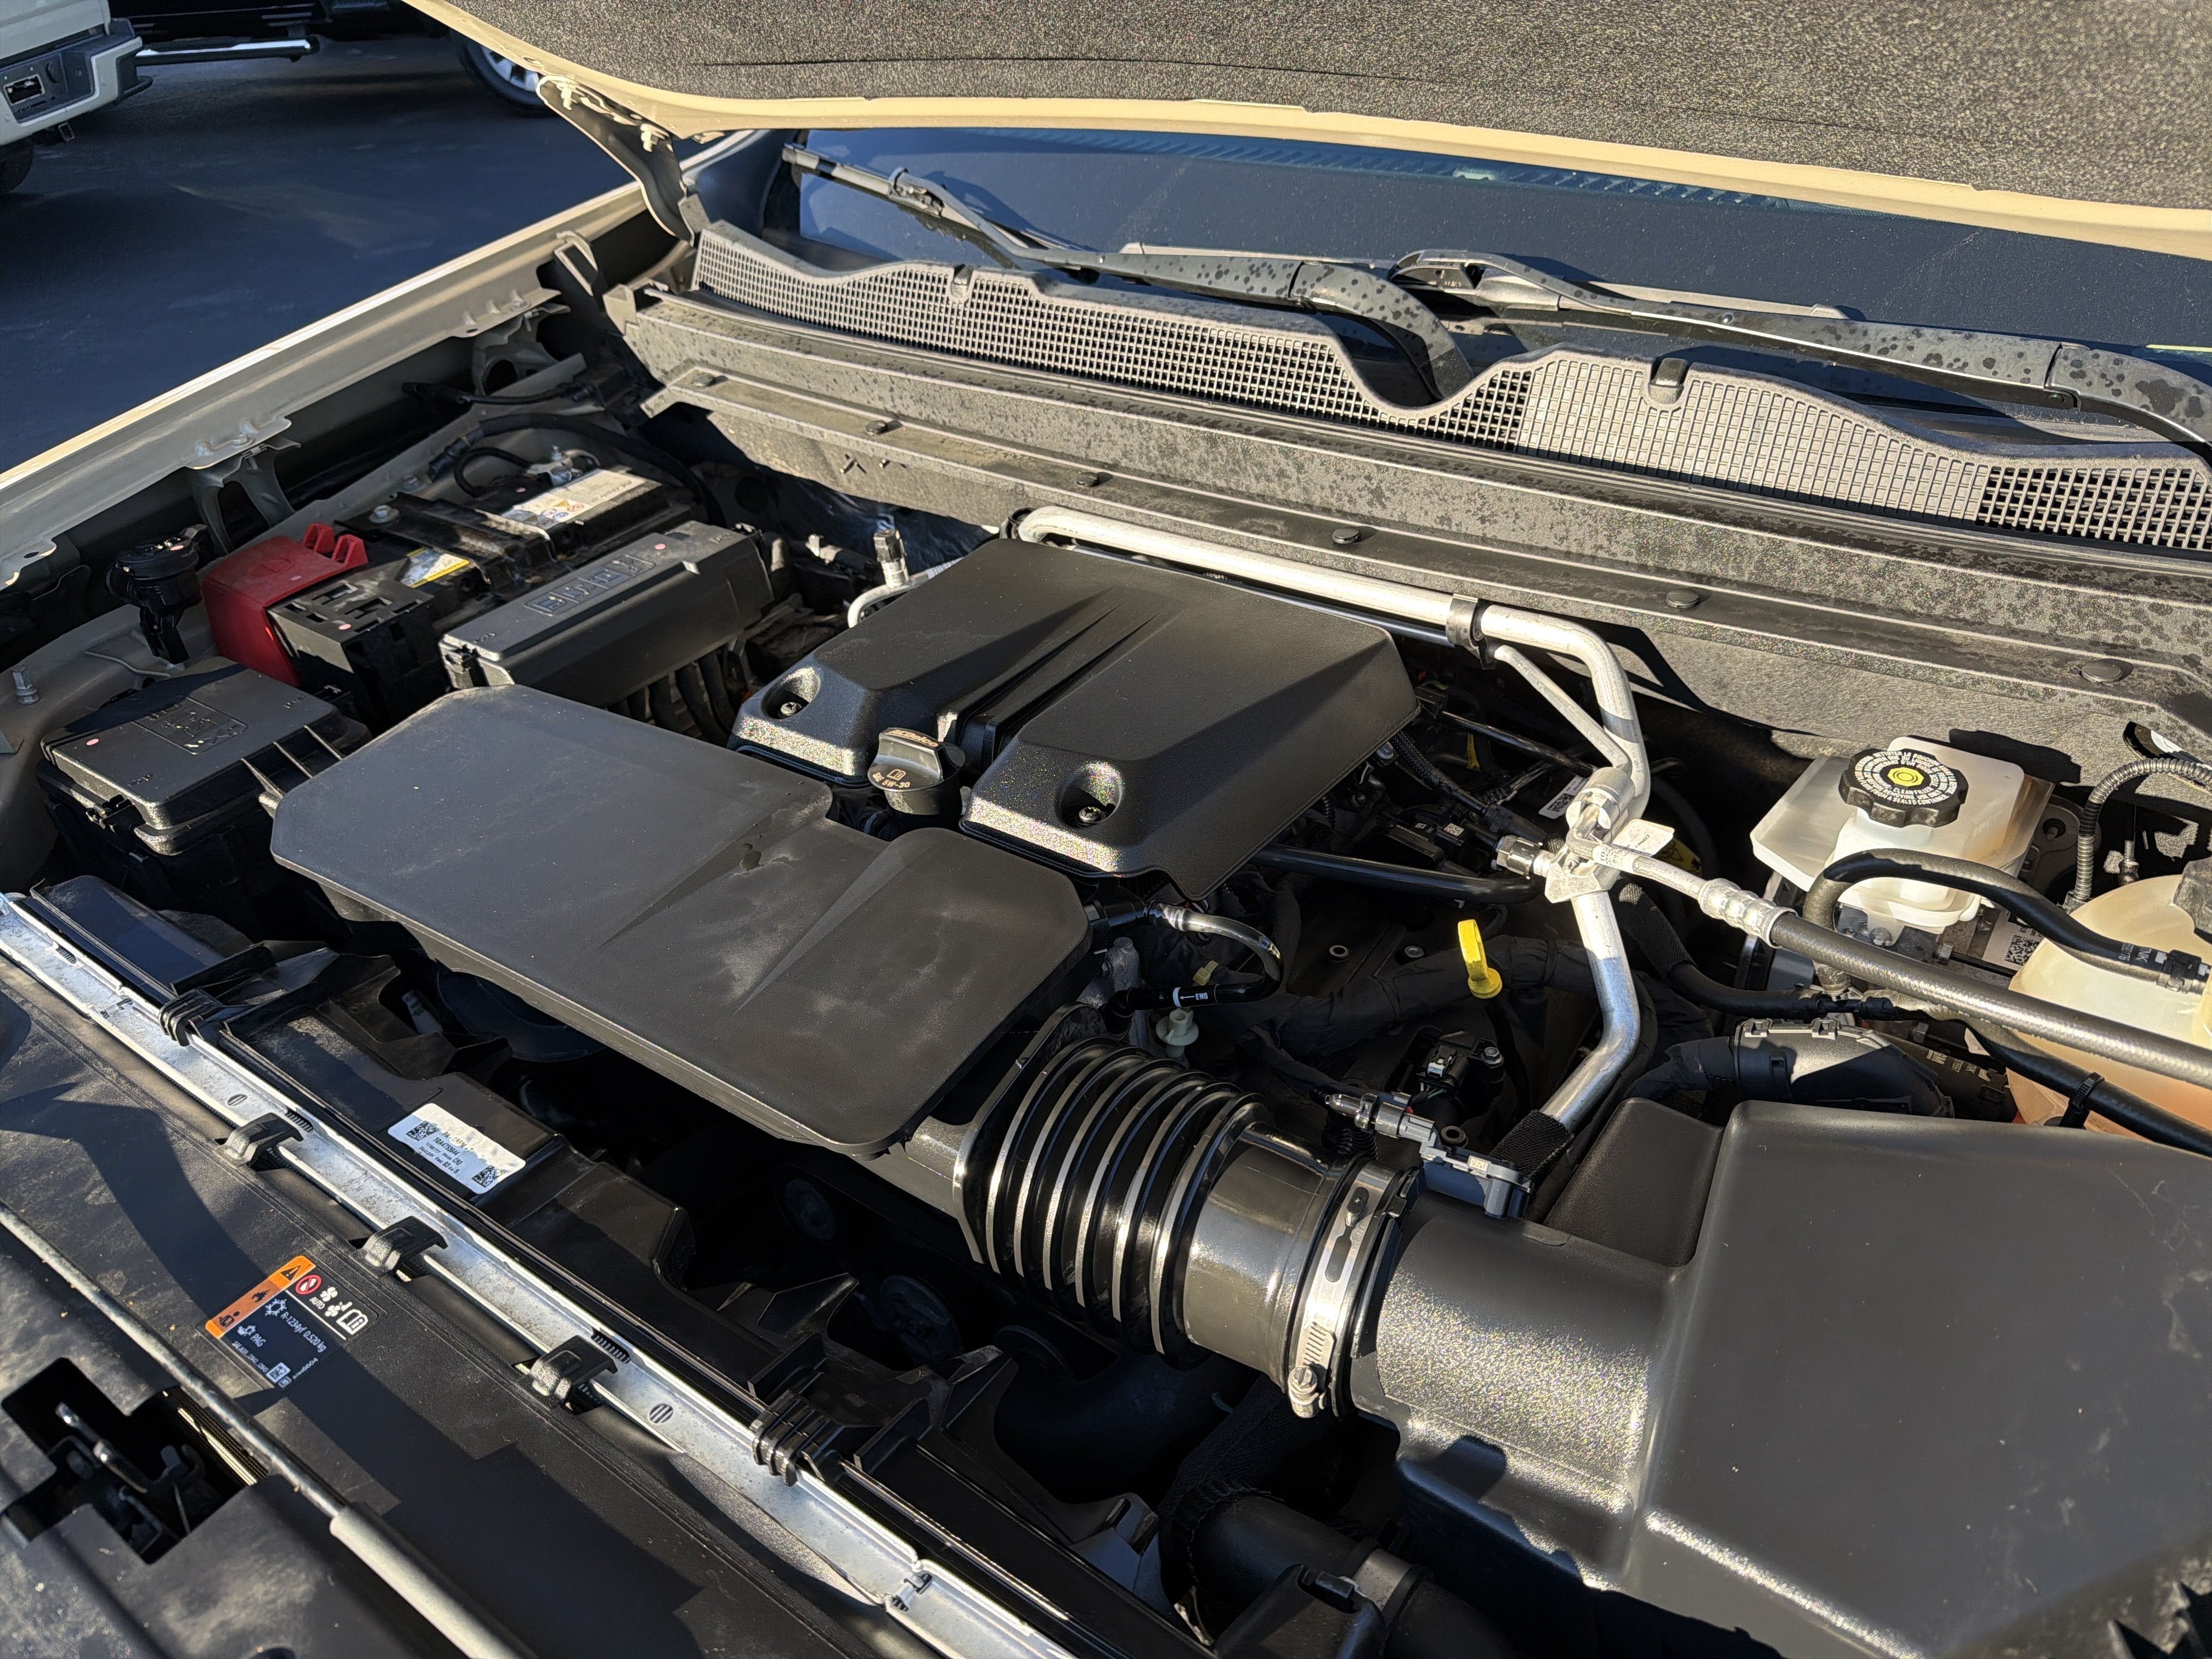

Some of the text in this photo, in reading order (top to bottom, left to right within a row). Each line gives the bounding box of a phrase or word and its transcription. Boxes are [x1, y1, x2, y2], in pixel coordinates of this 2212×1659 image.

[888, 730, 939, 747] ACDelco
[1912, 753, 1941, 766] BOUCHON
[872, 772, 911, 788] SAE 5W-30
[1869, 788, 1888, 798] FROM
[1195, 992, 1209, 1000] ENG
[309, 1296, 325, 1310] AUTO
[280, 1312, 327, 1353] R-1234yf 0.520 kg
[250, 1333, 267, 1347] PAG
